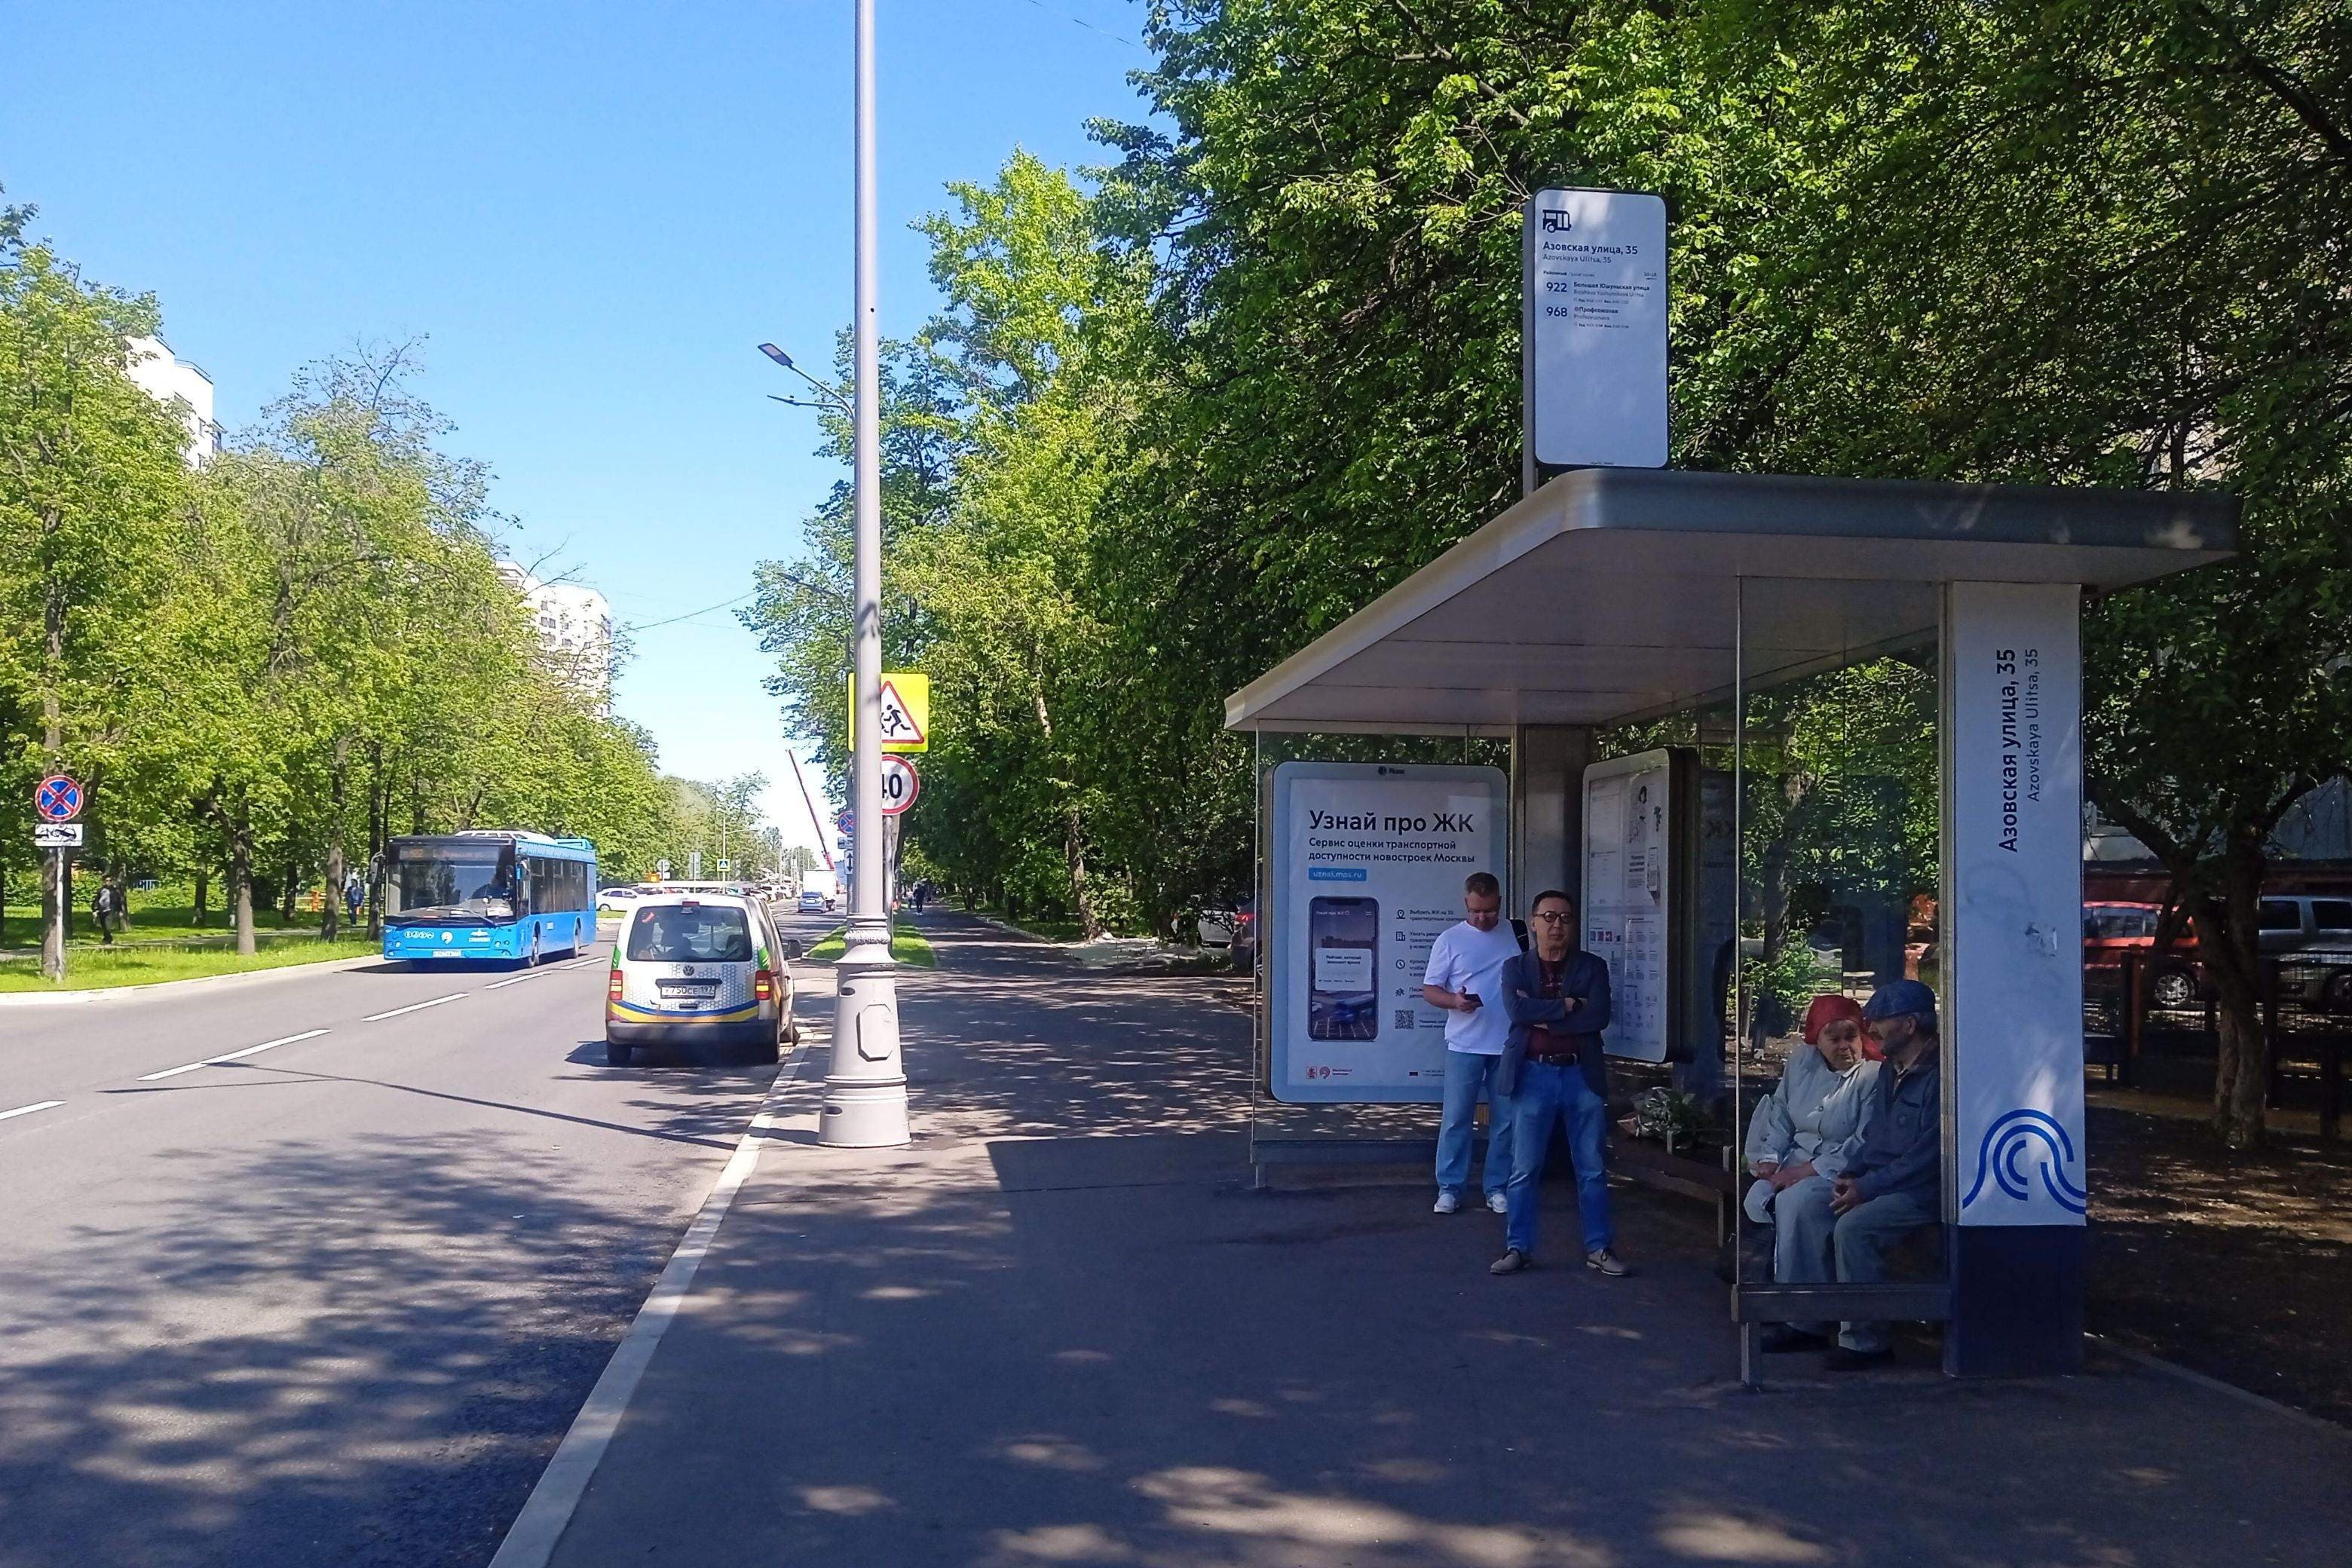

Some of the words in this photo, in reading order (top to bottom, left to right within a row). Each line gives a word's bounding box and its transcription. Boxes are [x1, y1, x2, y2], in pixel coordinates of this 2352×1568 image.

[1543, 241, 1589, 252] Азовская
[1591, 246, 1623, 255] улица,
[1625, 246, 1638, 255] 35
[1546, 282, 1567, 292] 922
[1546, 306, 1568, 317] 968
[1997, 648, 2016, 675] 35
[2025, 648, 2038, 667] 35
[2025, 671, 2040, 718] Ulitsa,
[2002, 680, 2021, 749] улица,
[2026, 724, 2041, 802] Azovskaya
[1999, 755, 2017, 853] Азовская
[1309, 810, 1377, 831] Узнай
[1384, 817, 1426, 835] про
[1432, 813, 1474, 832] ЖК
[1309, 838, 1345, 848] Сервис
[1348, 840, 1383, 849] оценки
[1386, 841, 1456, 850] транспортной
[1309, 852, 1370, 862] доступности
[1374, 853, 1432, 862] новостроек
[1434, 853, 1475, 862] Москвы
